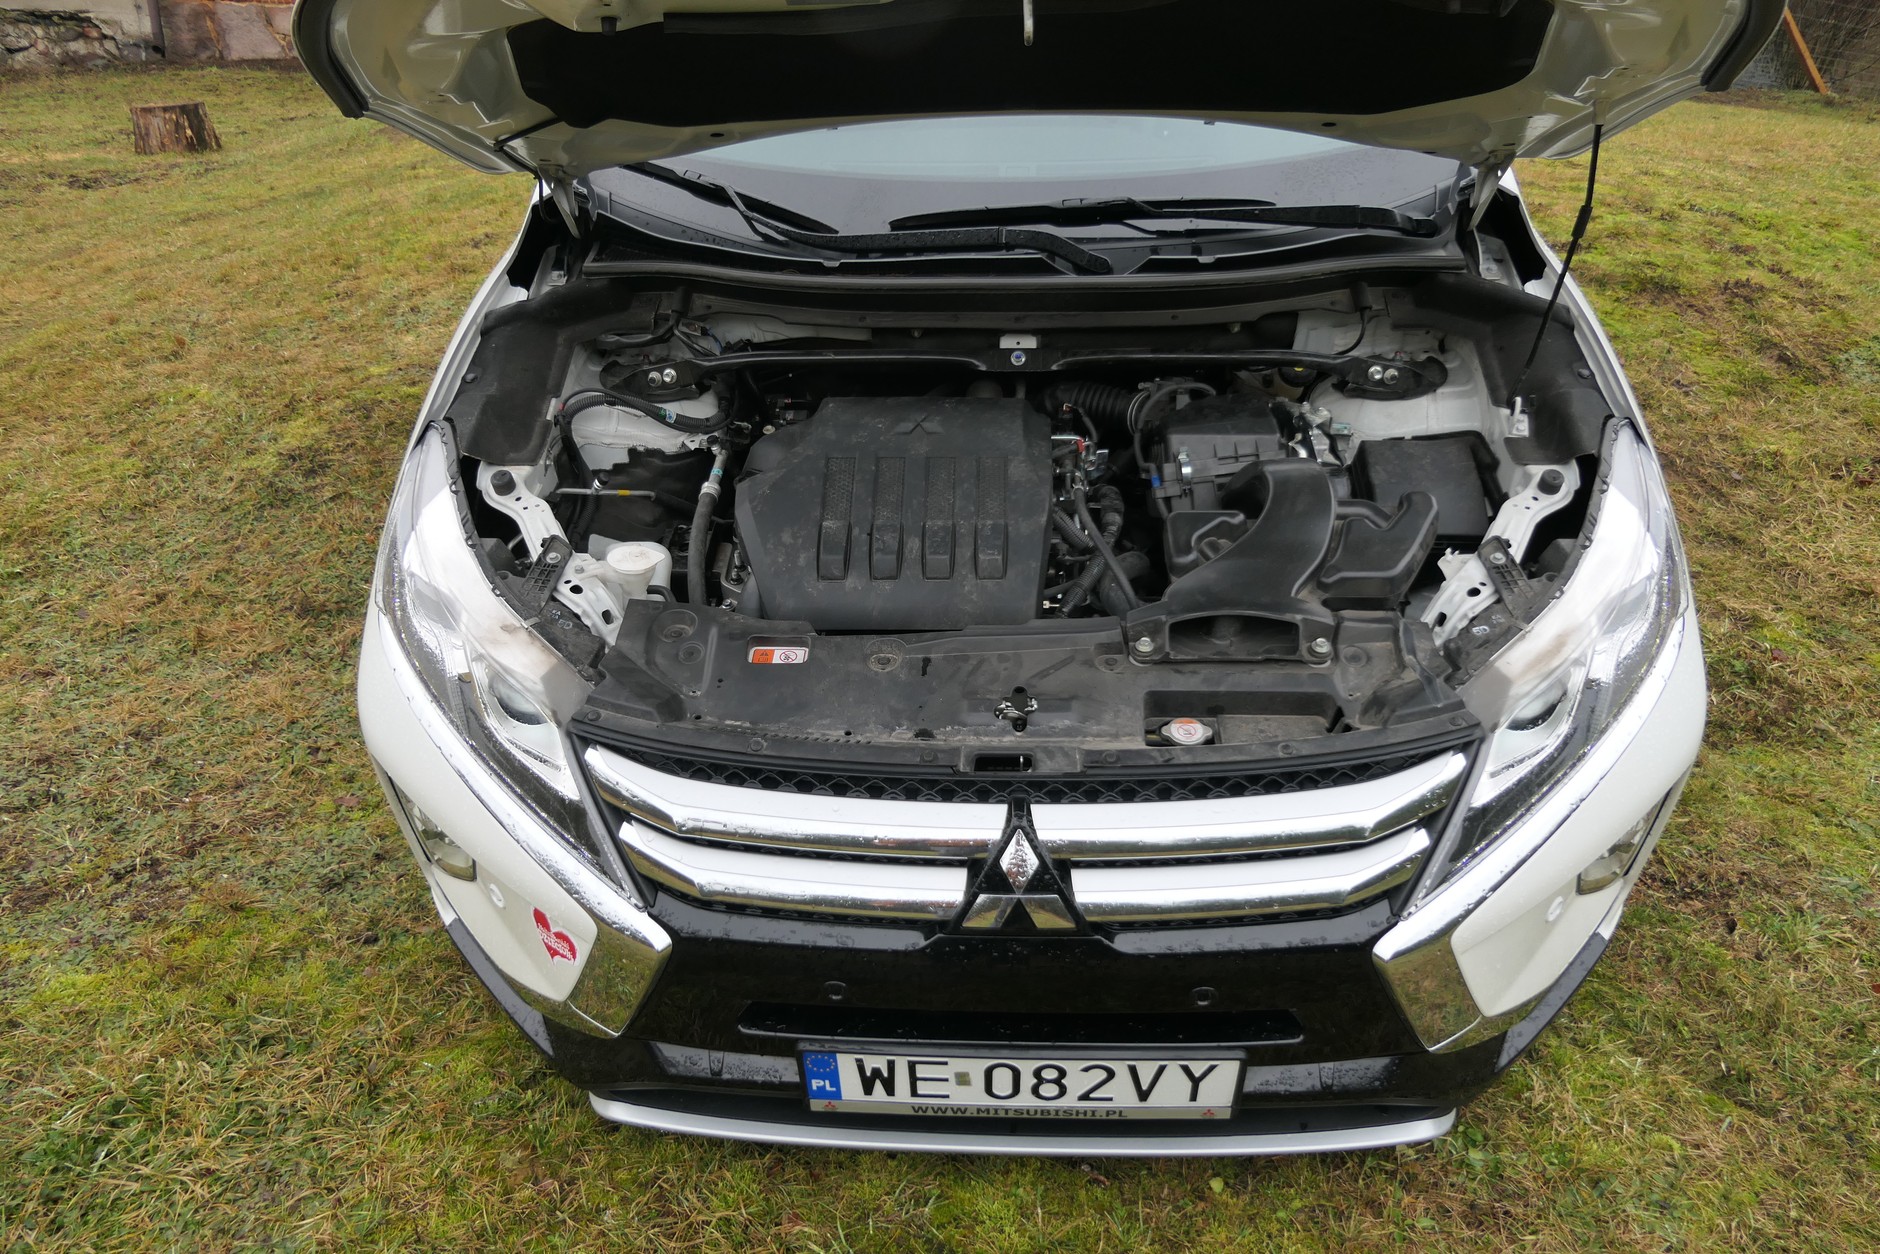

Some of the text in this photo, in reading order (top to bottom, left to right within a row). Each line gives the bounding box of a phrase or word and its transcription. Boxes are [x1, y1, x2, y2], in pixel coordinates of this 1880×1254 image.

[811, 1078, 837, 1092] PL
[854, 1057, 1220, 1103] WE 082VY
[911, 1105, 1128, 1119] WWW.MITSUBISHI.PL
